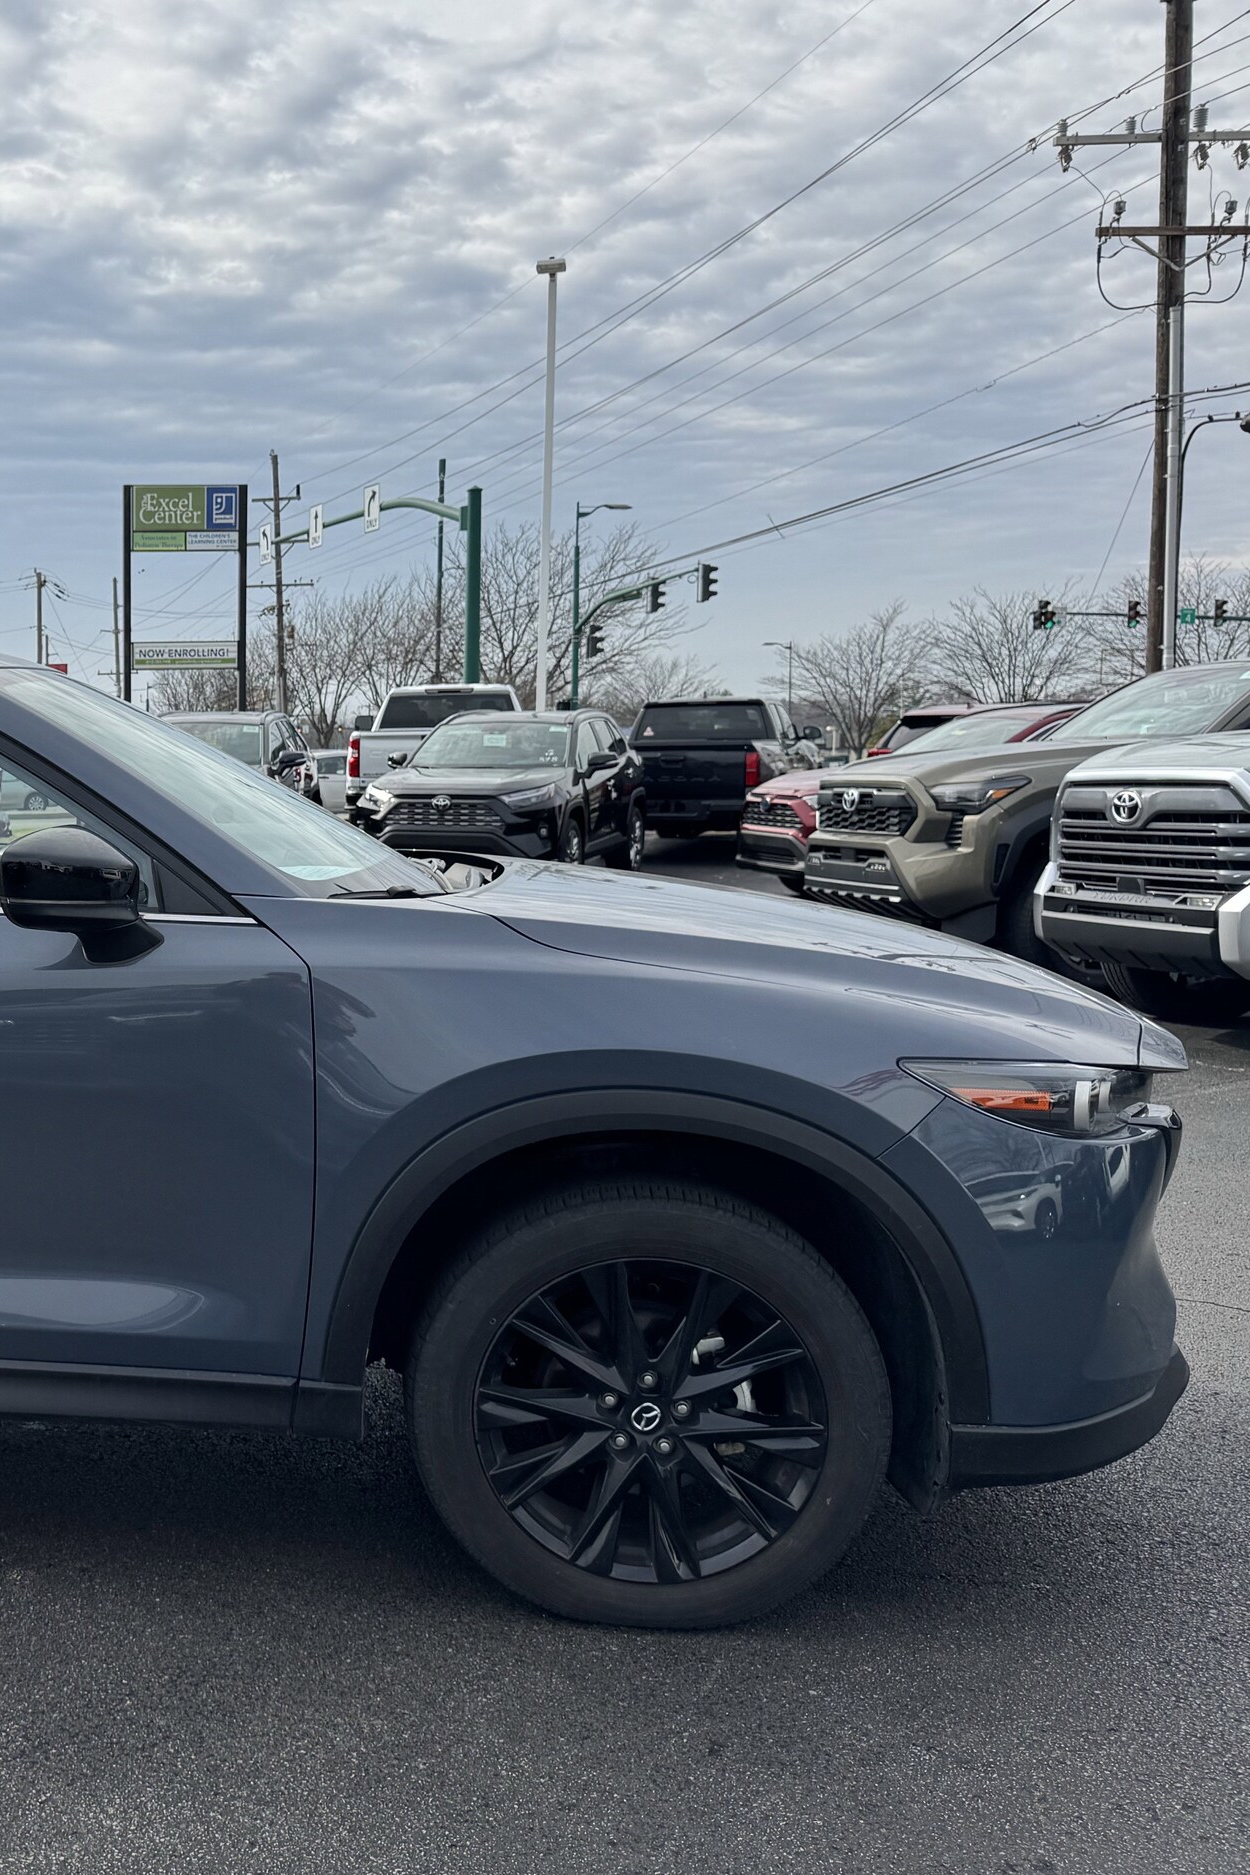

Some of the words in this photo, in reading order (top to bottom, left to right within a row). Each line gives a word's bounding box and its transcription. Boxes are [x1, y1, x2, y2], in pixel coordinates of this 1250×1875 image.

[146, 492, 193, 511] Excel
[139, 507, 201, 524] Center
[366, 518, 378, 529] ONLY
[138, 649, 165, 658] NOW
[167, 648, 229, 658] ENROLLING!
